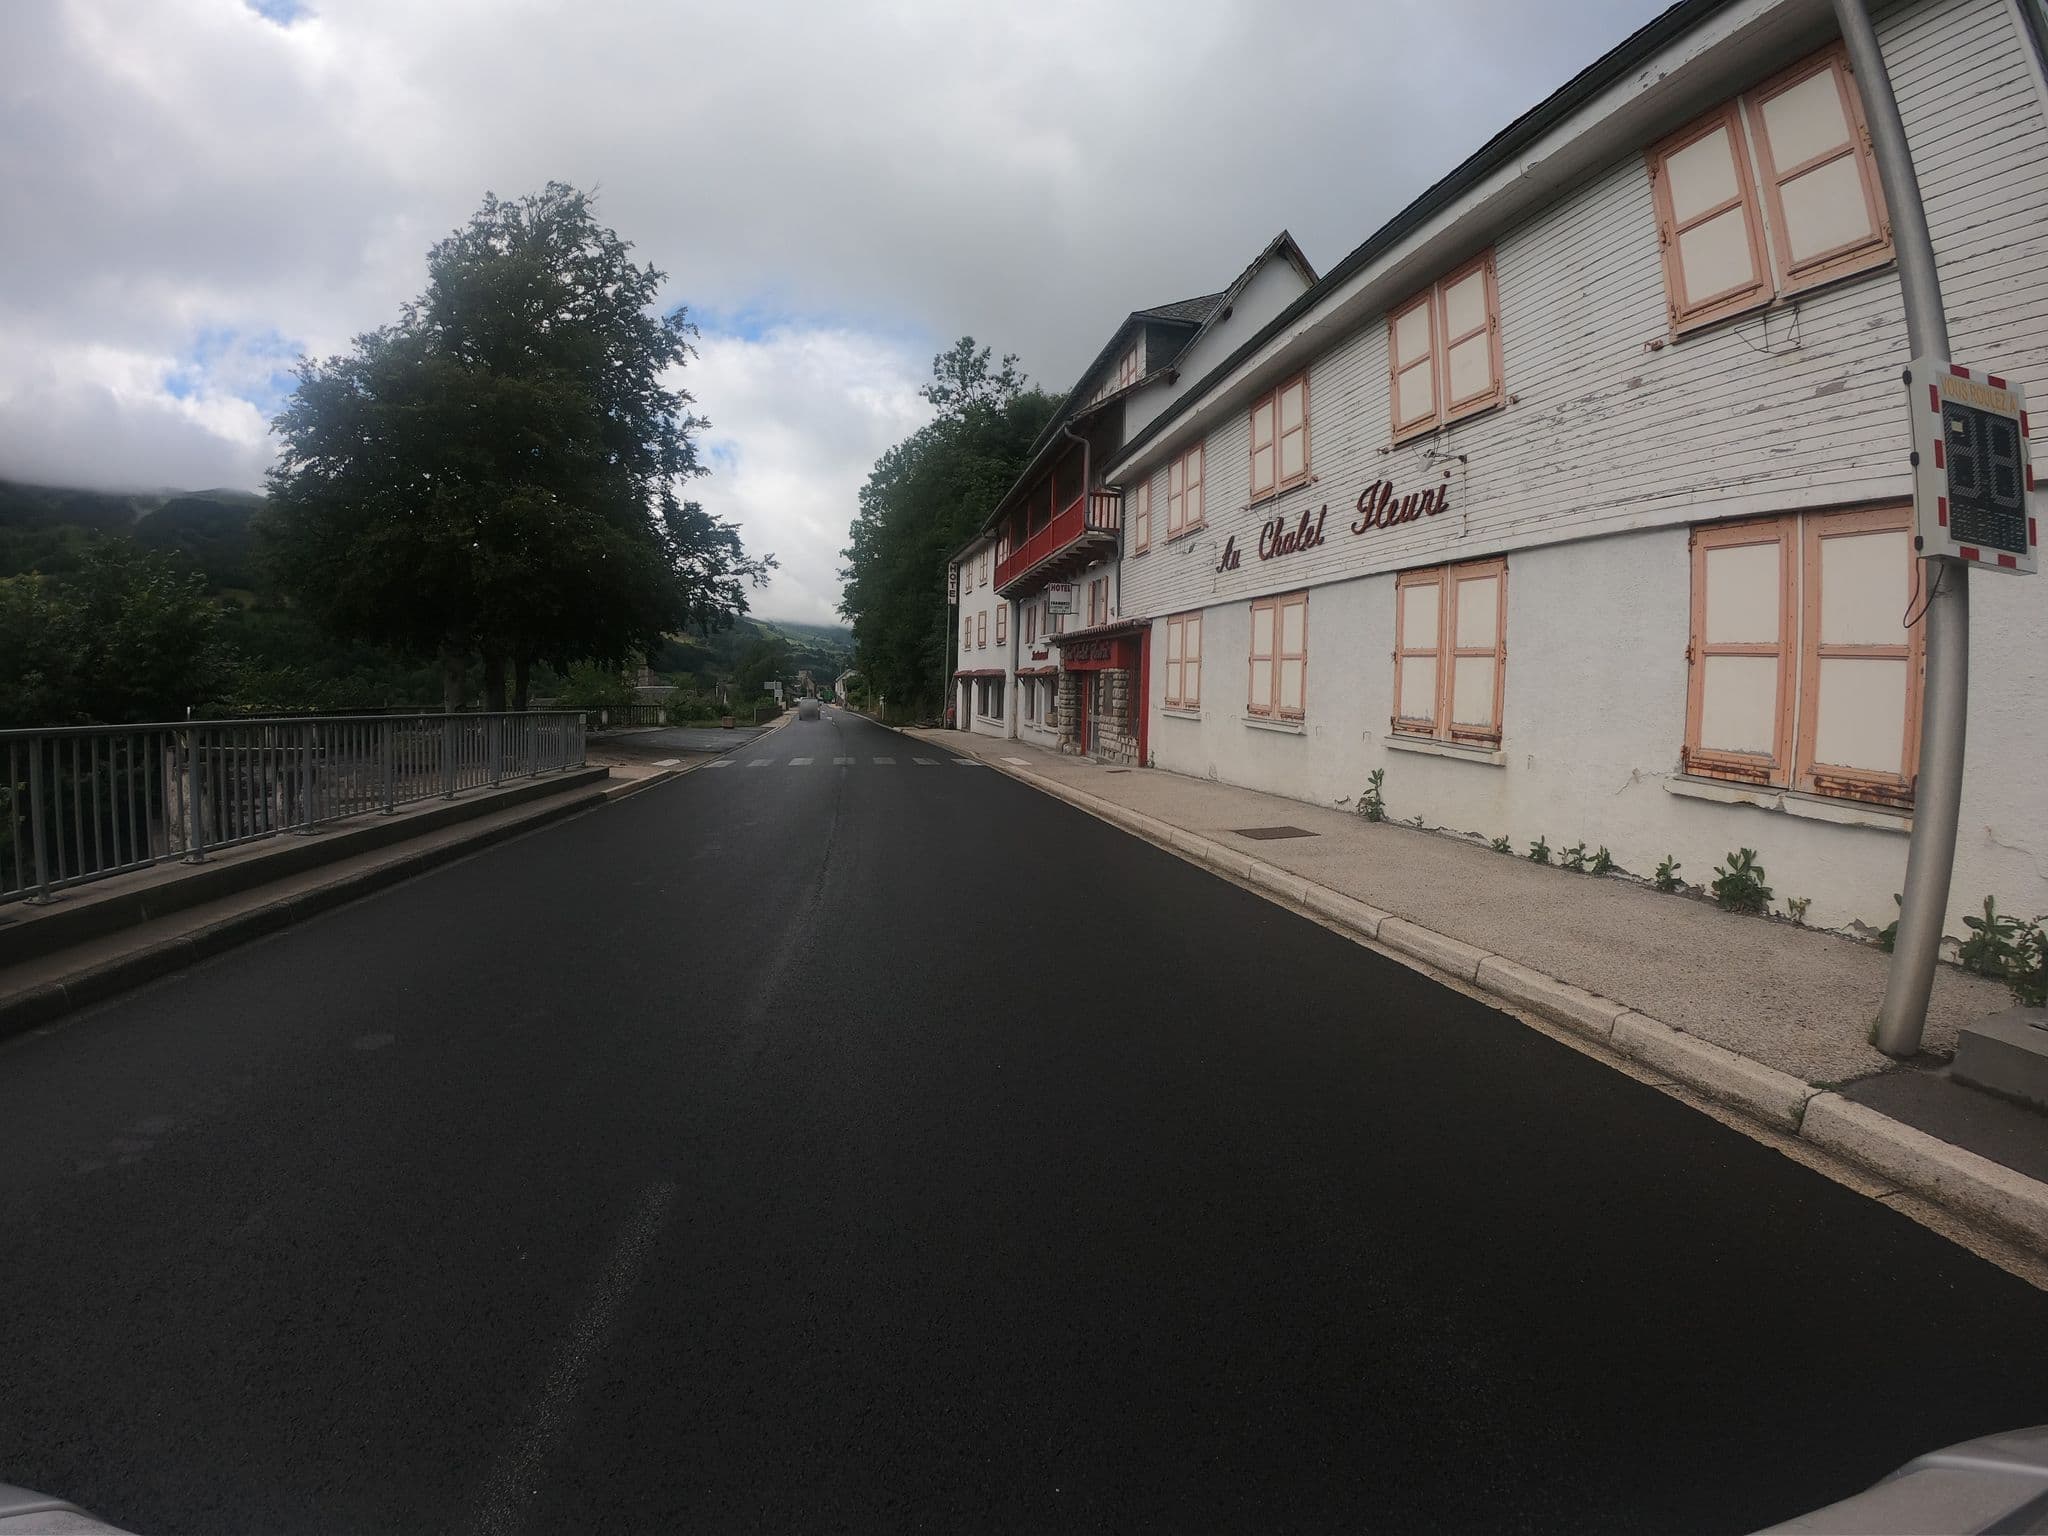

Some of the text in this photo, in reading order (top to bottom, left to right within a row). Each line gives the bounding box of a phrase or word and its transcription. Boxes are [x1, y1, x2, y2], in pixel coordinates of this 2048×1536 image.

[1941, 376, 1969, 401] VOUS
[1970, 384, 2005, 410] ROULEZ
[1216, 471, 1451, 573] Au Chalet Fleuri
[949, 565, 957, 605] HOTEL
[1051, 583, 1071, 592] HOTEL
